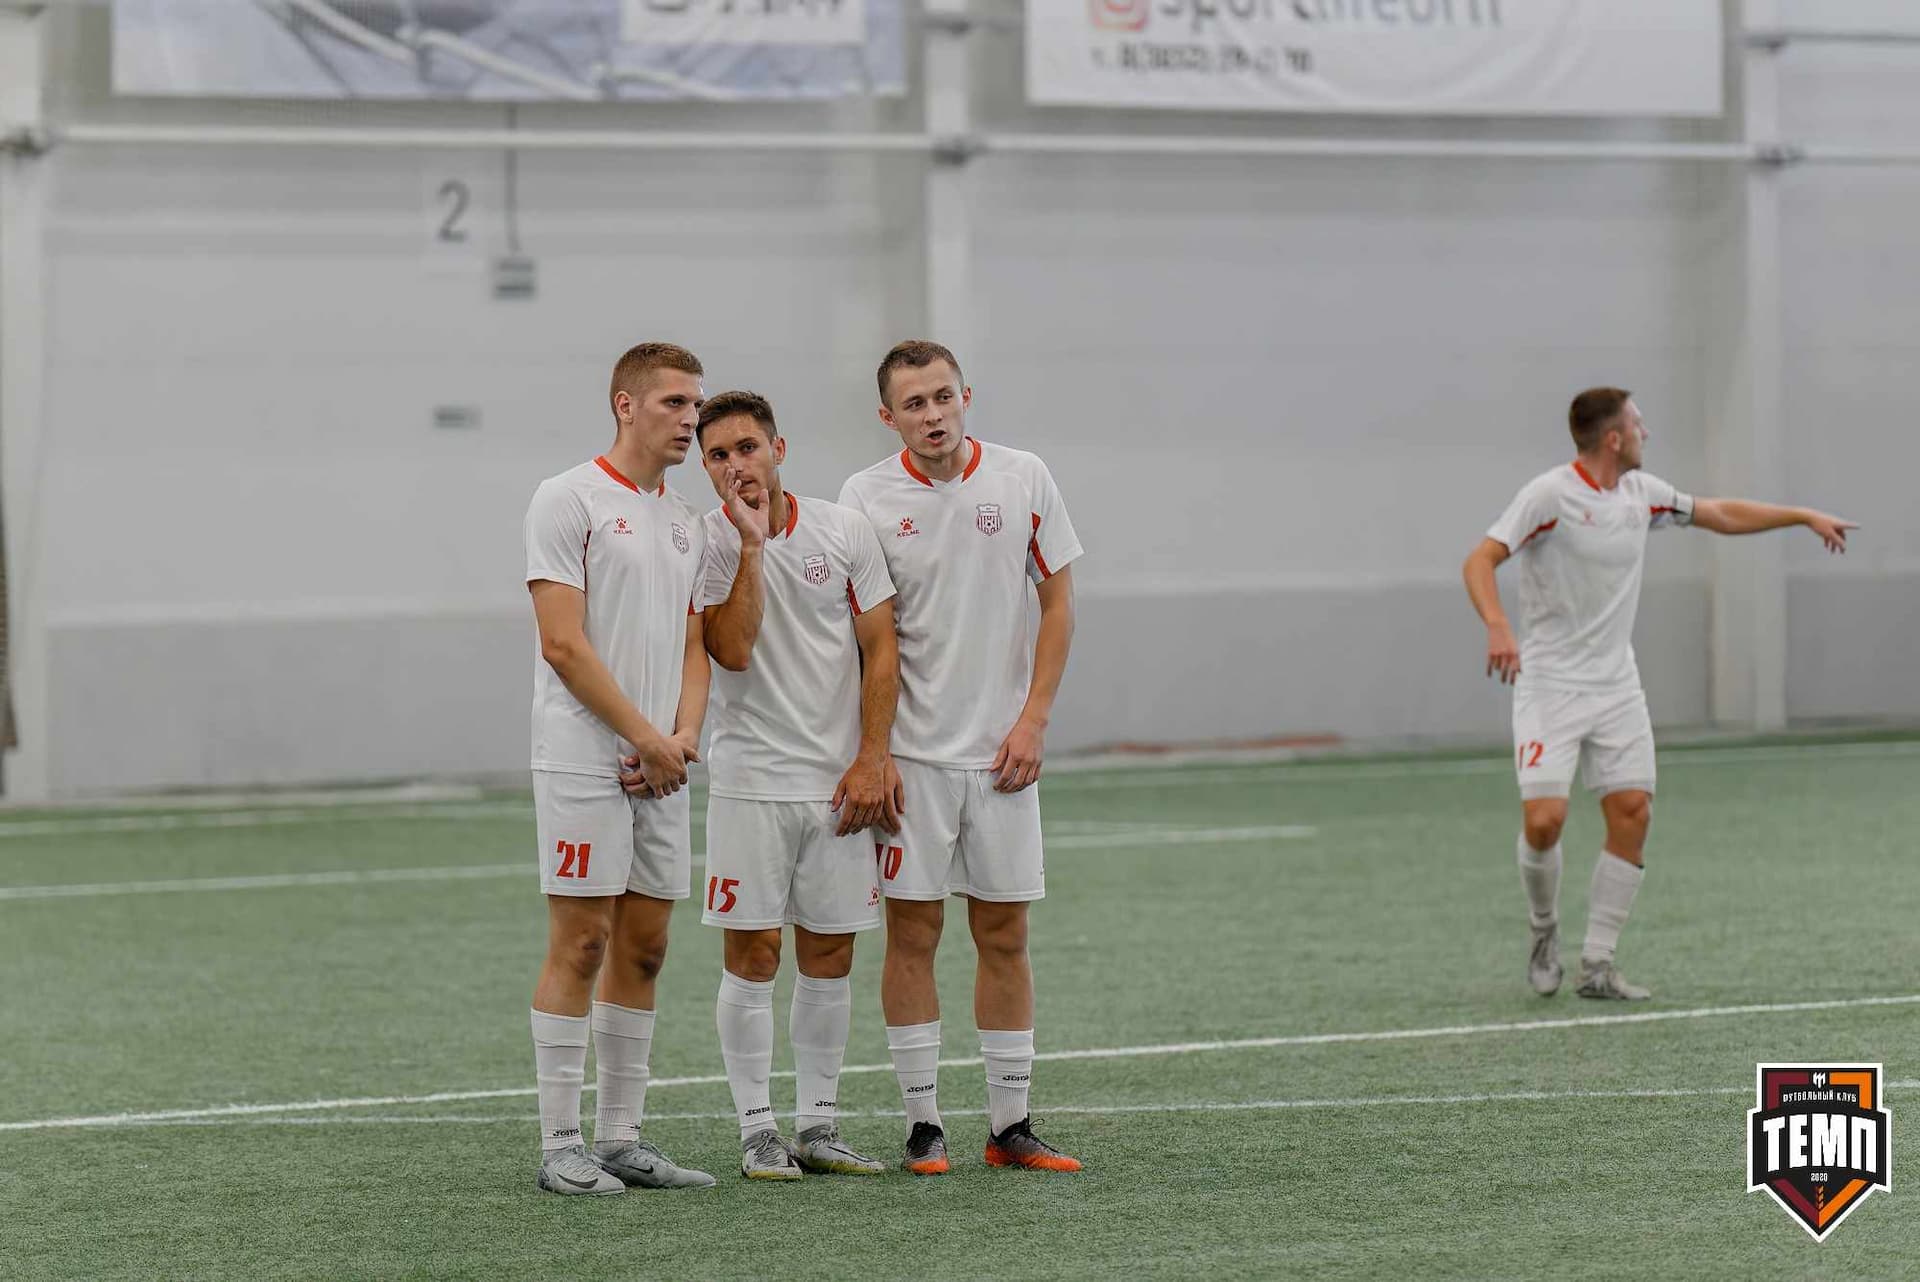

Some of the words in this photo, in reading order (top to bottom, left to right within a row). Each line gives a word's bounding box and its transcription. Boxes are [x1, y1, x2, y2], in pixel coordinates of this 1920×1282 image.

[437, 179, 470, 244] 2
[896, 529, 920, 539] KELME
[1519, 741, 1544, 770] 12
[556, 840, 590, 877] 21
[708, 876, 740, 913] 15
